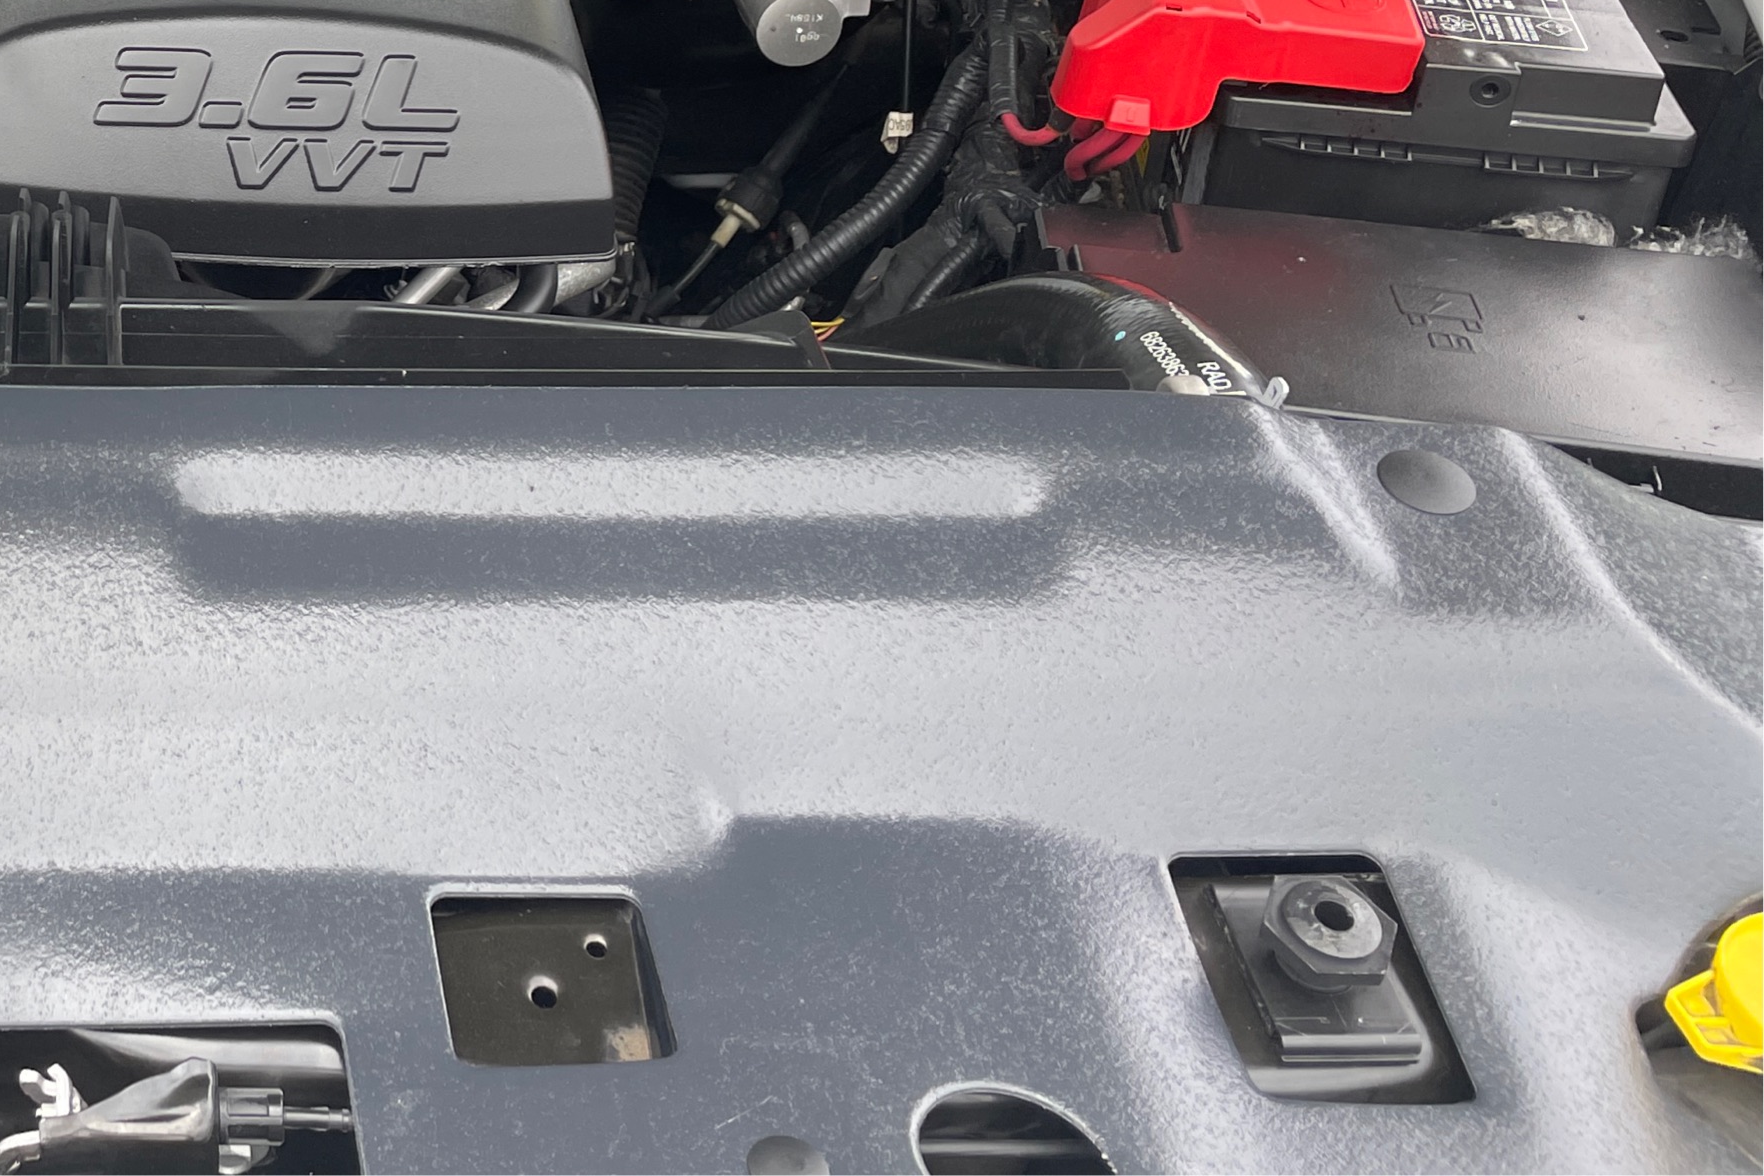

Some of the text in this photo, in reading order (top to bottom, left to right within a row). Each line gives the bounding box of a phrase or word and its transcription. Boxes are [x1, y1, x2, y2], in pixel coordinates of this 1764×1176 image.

[93, 46, 460, 133] 3.6L
[226, 136, 451, 194] VVT
[1197, 361, 1232, 390] RAD
